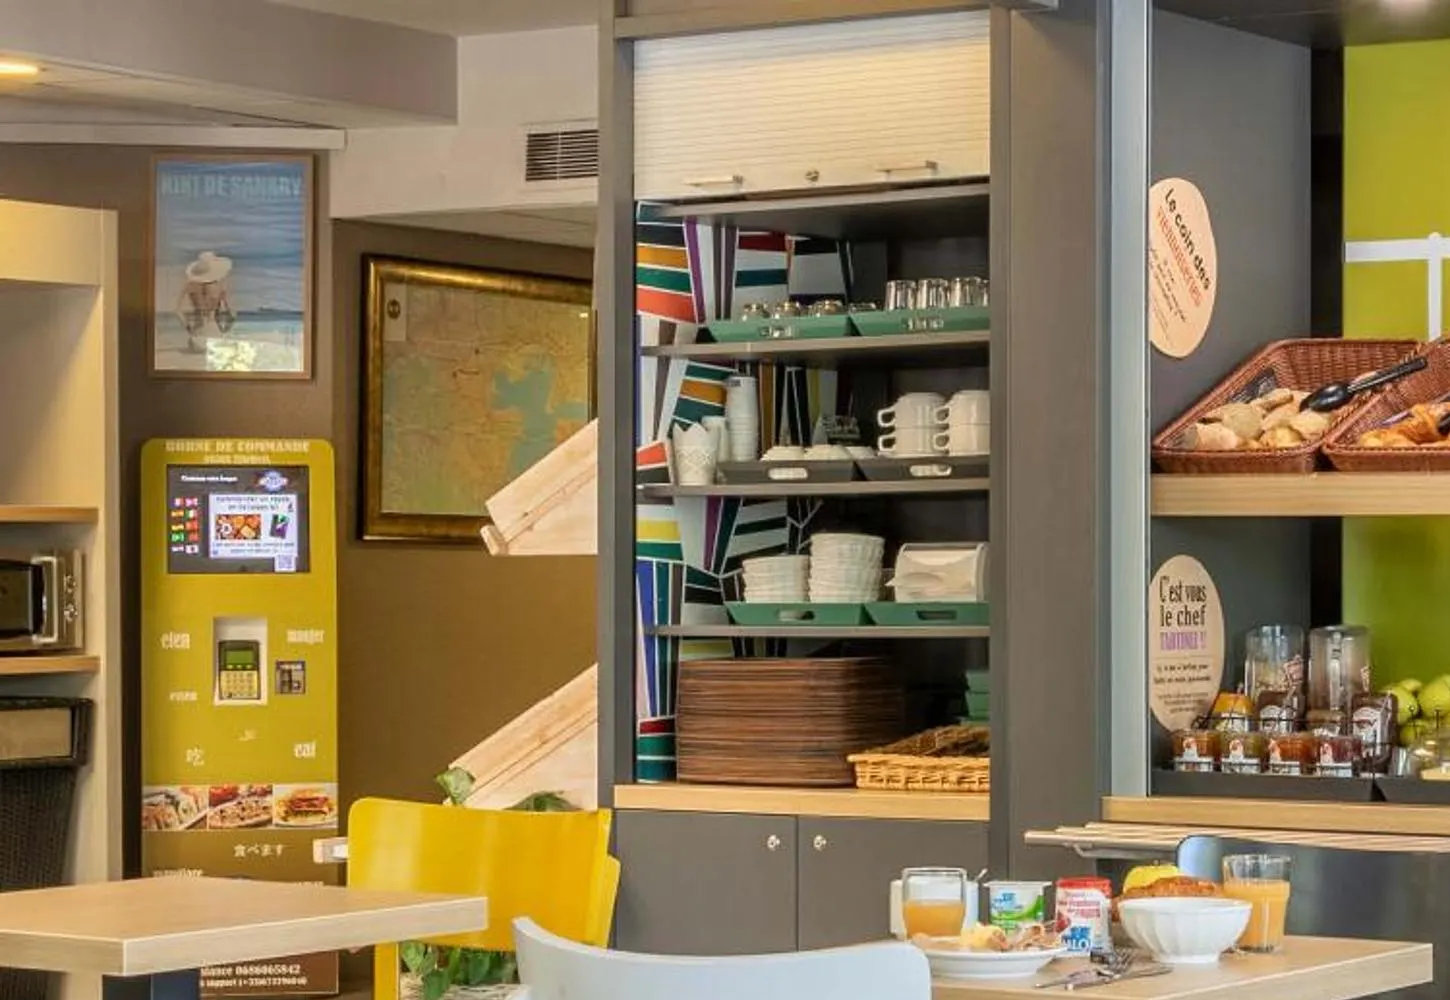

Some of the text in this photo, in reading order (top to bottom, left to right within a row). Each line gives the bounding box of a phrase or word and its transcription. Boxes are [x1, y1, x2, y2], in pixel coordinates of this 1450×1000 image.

[1174, 213, 1196, 255] coin
[1193, 254, 1211, 290] des
[215, 439, 235, 453] DE
[1159, 575, 1207, 603] C'est vous
[1159, 604, 1207, 627] le chef
